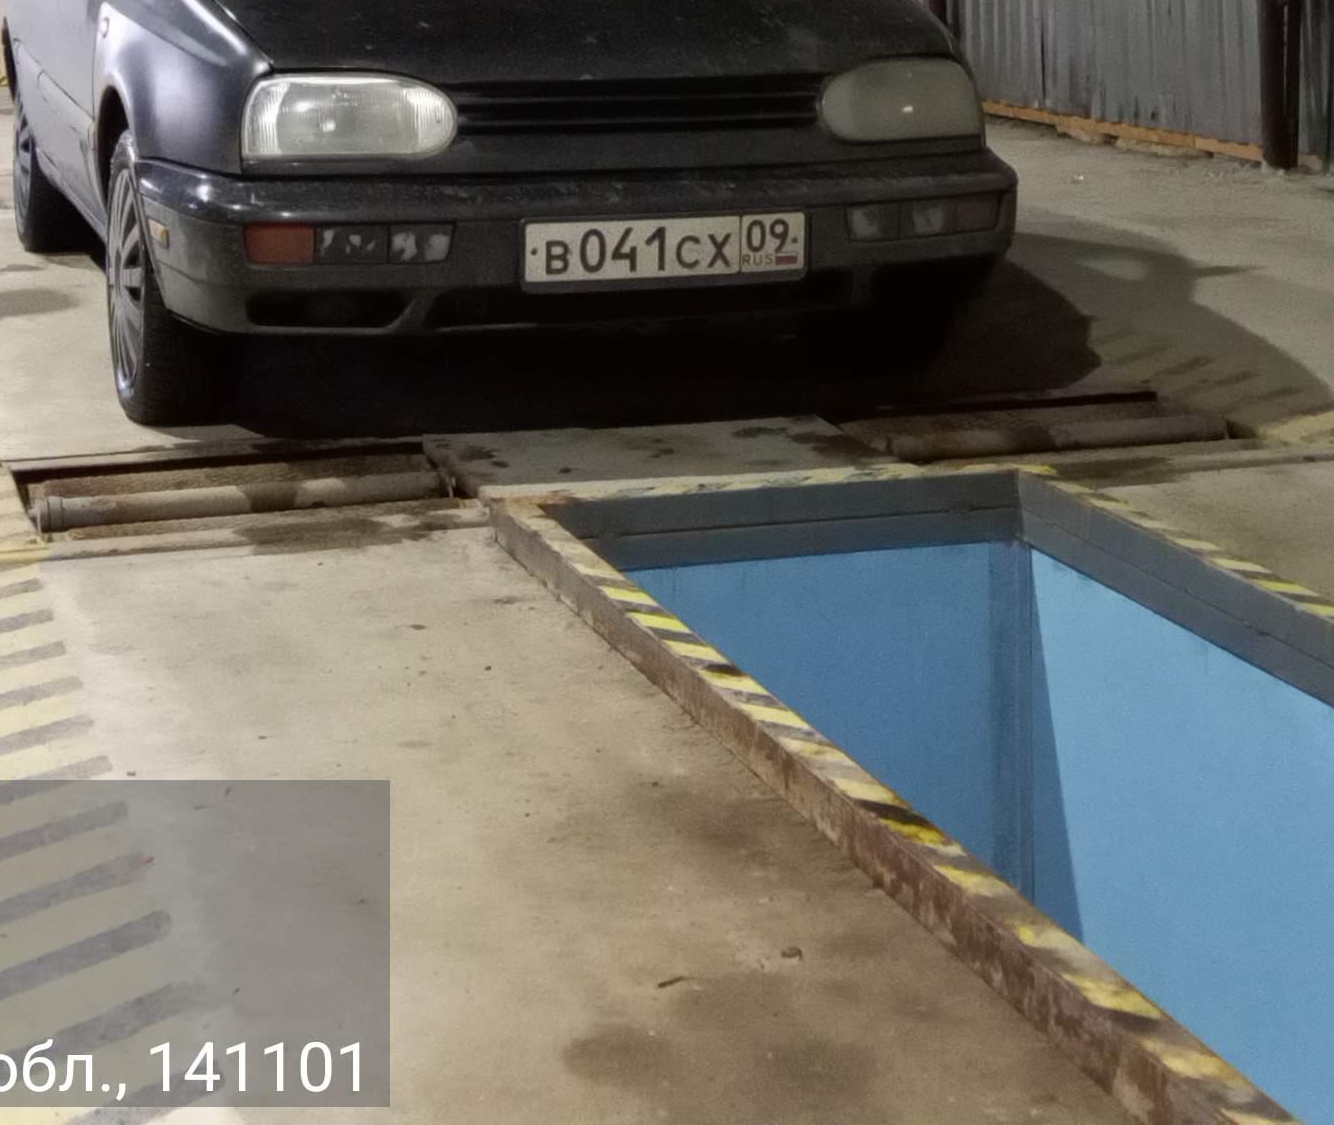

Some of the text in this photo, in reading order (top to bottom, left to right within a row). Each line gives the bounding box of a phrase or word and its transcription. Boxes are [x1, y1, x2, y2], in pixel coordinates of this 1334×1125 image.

[544, 218, 790, 275] В041СХ 09
[742, 253, 774, 266] RUS
